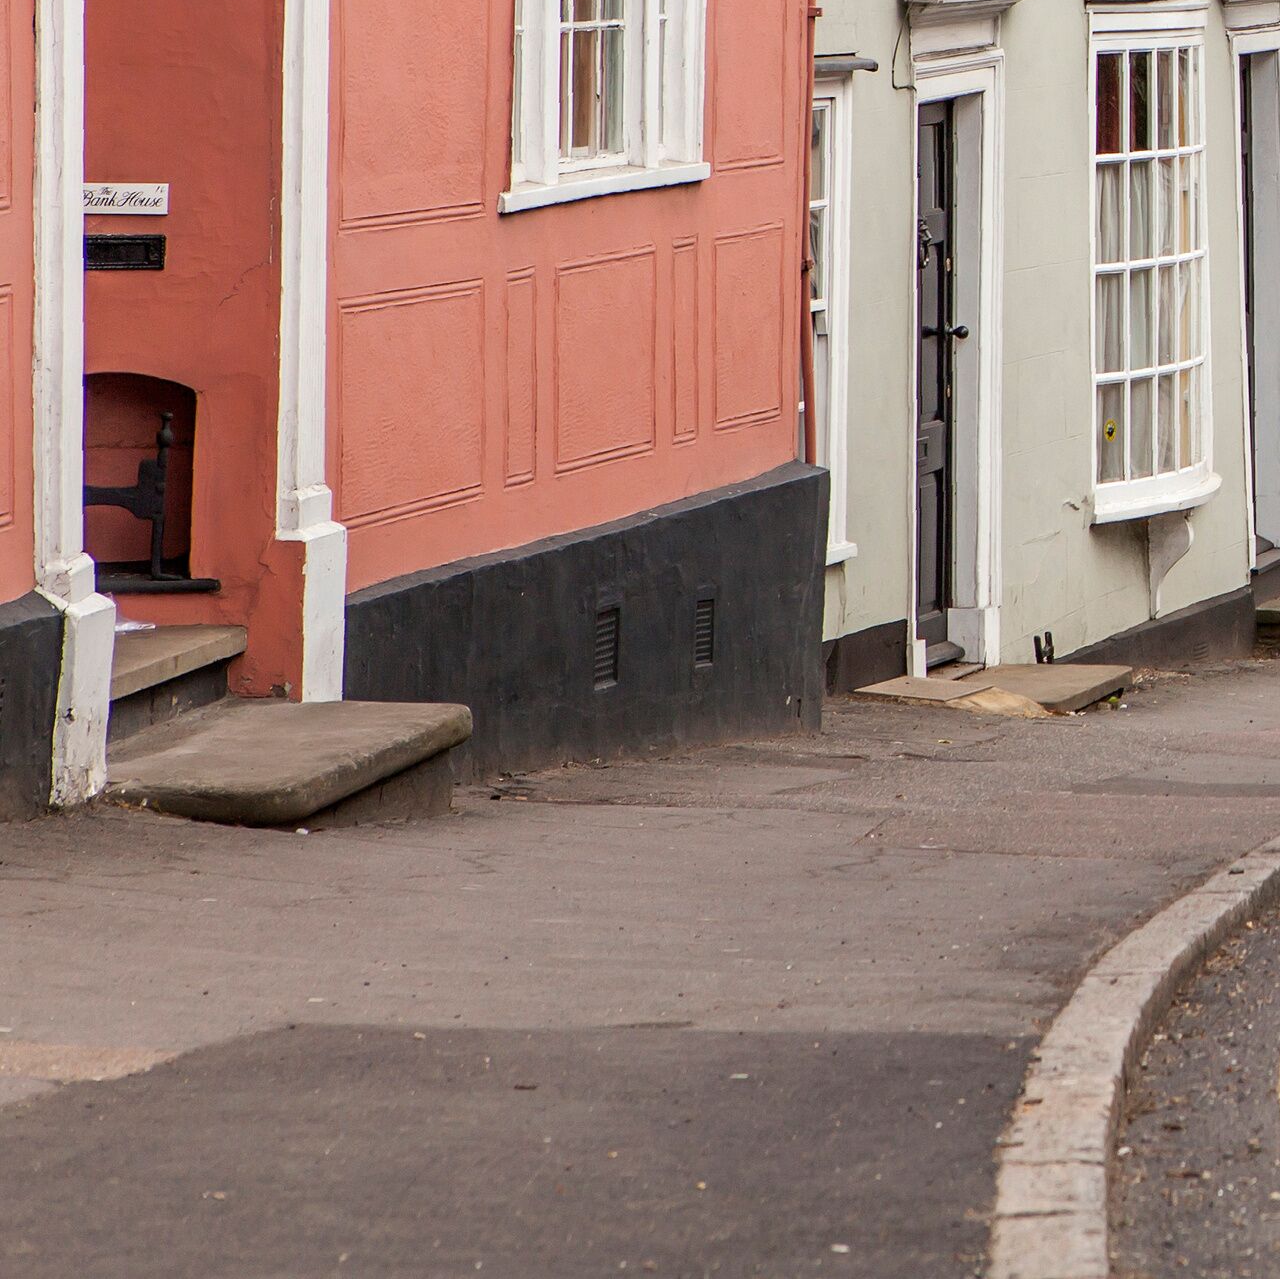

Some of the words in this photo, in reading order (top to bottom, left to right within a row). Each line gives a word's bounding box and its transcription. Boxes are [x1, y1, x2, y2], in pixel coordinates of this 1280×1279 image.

[100, 186, 113, 196] The
[83, 190, 117, 207] Bank
[117, 191, 164, 208] House
